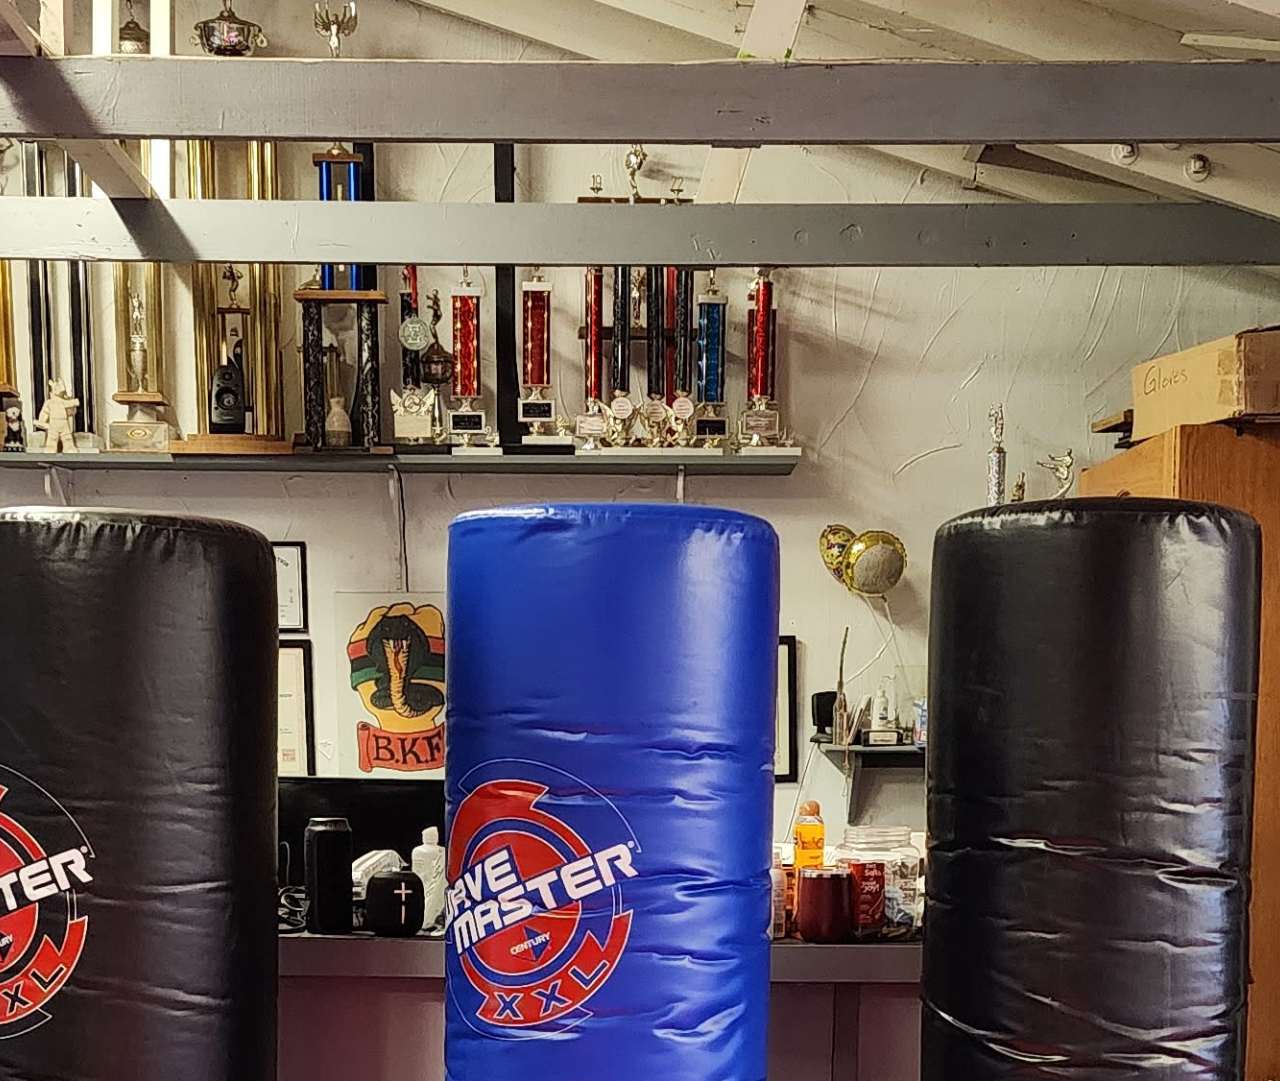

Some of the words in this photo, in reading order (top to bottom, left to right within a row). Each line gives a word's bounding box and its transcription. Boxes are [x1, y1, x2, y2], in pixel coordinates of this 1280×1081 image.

[1143, 365, 1188, 396] Gloves
[453, 843, 639, 954] MASTER
[510, 931, 551, 955] CENTURY
[493, 960, 609, 1020] XXL
